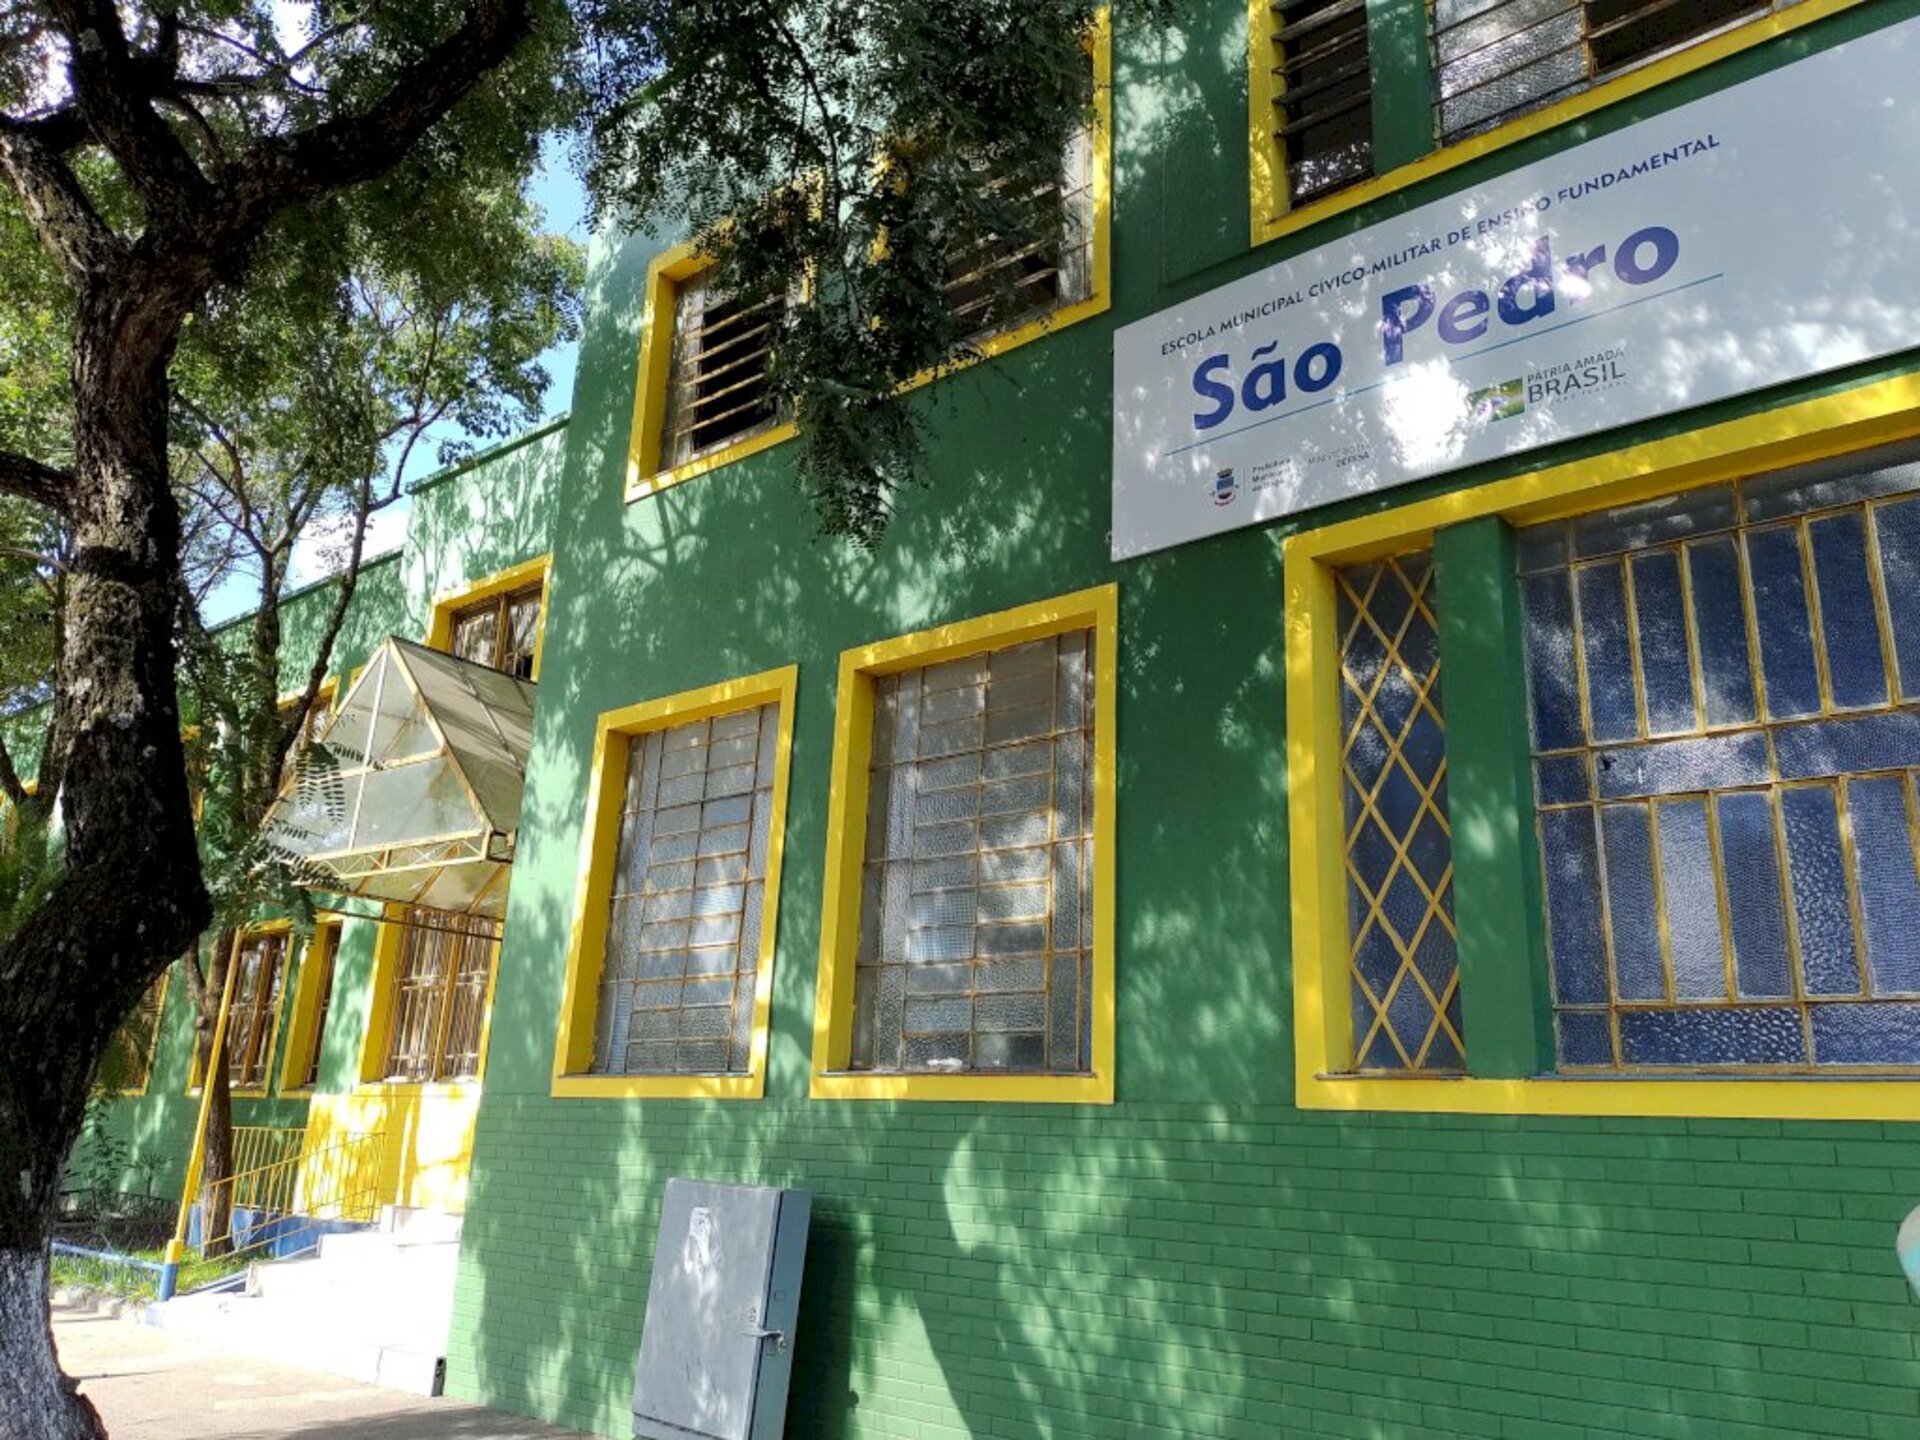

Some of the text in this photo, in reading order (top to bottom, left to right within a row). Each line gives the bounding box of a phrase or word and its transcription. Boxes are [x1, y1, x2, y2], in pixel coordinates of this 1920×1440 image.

[1161, 326, 1216, 356] ESCOLA
[1219, 291, 1304, 333] MUNICIPAL
[1447, 225, 1472, 247] DE
[1557, 133, 1720, 205] FUNDAMENTAL
[1192, 226, 1680, 430] São Pedro
[1528, 361, 1627, 404] BRASIL
[1574, 347, 1625, 370] AMADA
